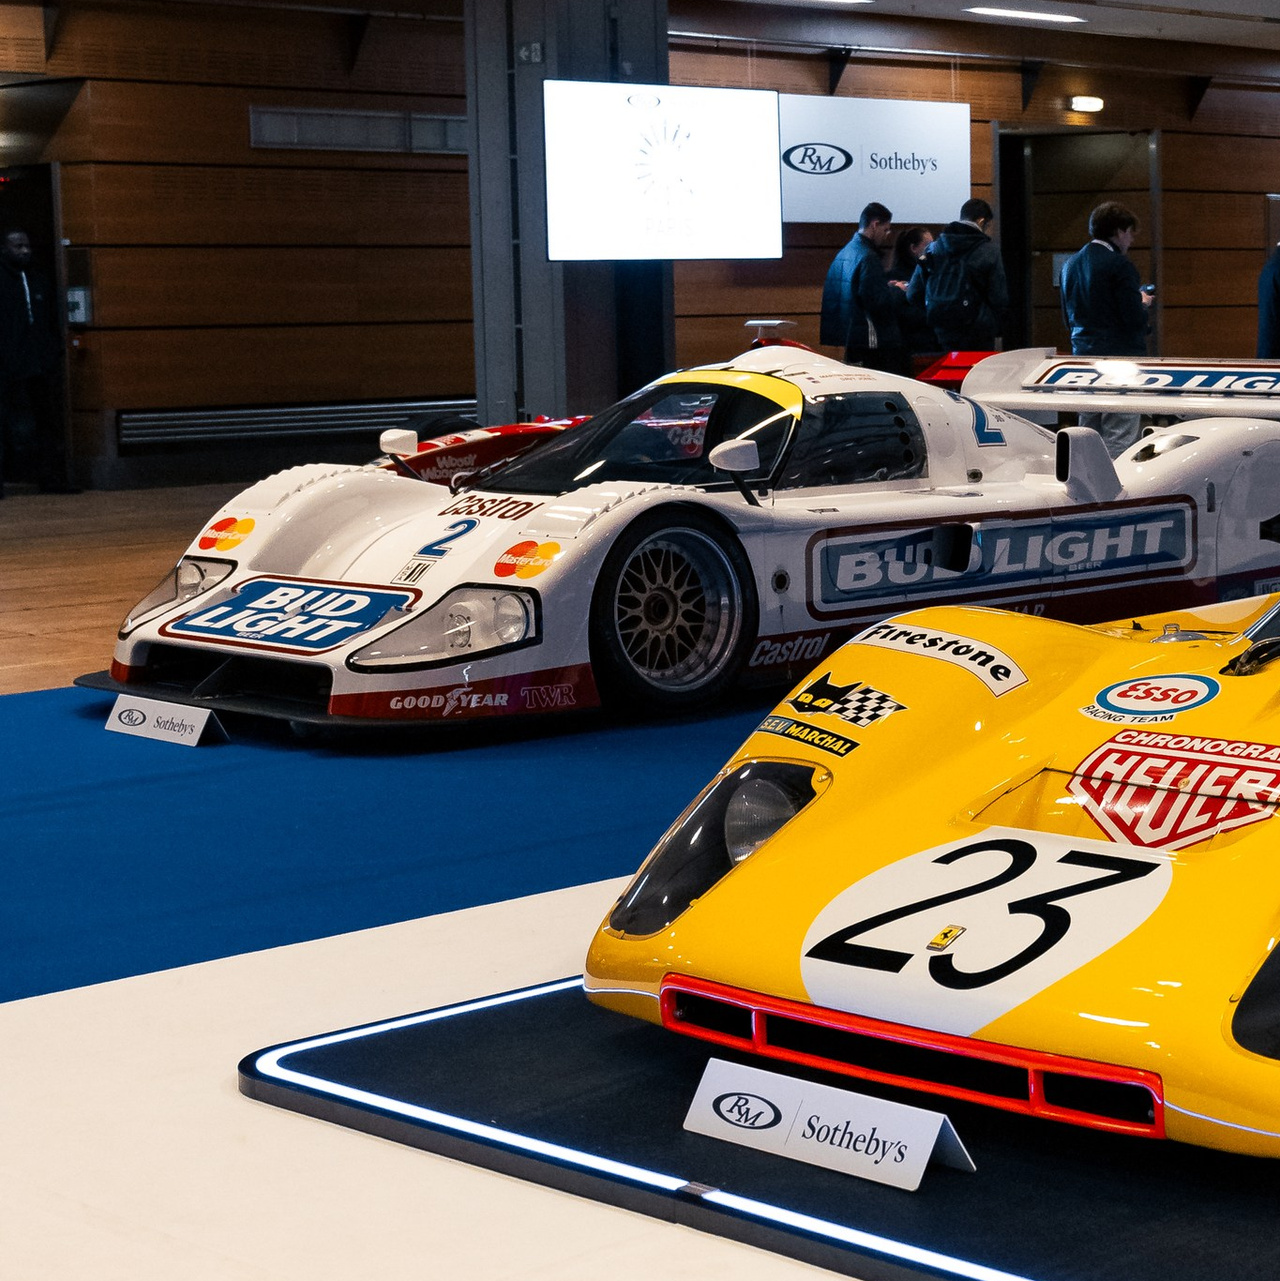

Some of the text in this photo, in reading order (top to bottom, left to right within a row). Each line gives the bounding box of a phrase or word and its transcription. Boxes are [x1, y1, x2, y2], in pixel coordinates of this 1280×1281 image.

[870, 151, 938, 175] Sotheby's
[437, 495, 545, 521] Castrol
[414, 518, 480, 559] 2
[991, 520, 1174, 572] LIGHT
[1068, 560, 1103, 572] BEER
[246, 586, 371, 617] BUD
[184, 606, 363, 641] LIGHT
[236, 630, 265, 640] BEER
[749, 632, 831, 667] Castrol
[860, 623, 1012, 682] Firestone
[521, 683, 577, 709] TWR
[153, 715, 196, 737] Sotheby's
[1082, 704, 1175, 724] RACING TEAM
[785, 723, 852, 754] MARCHAL
[1092, 748, 1268, 841] HEUER
[804, 838, 1162, 991] 23
[801, 1114, 908, 1165] Sotheby's
